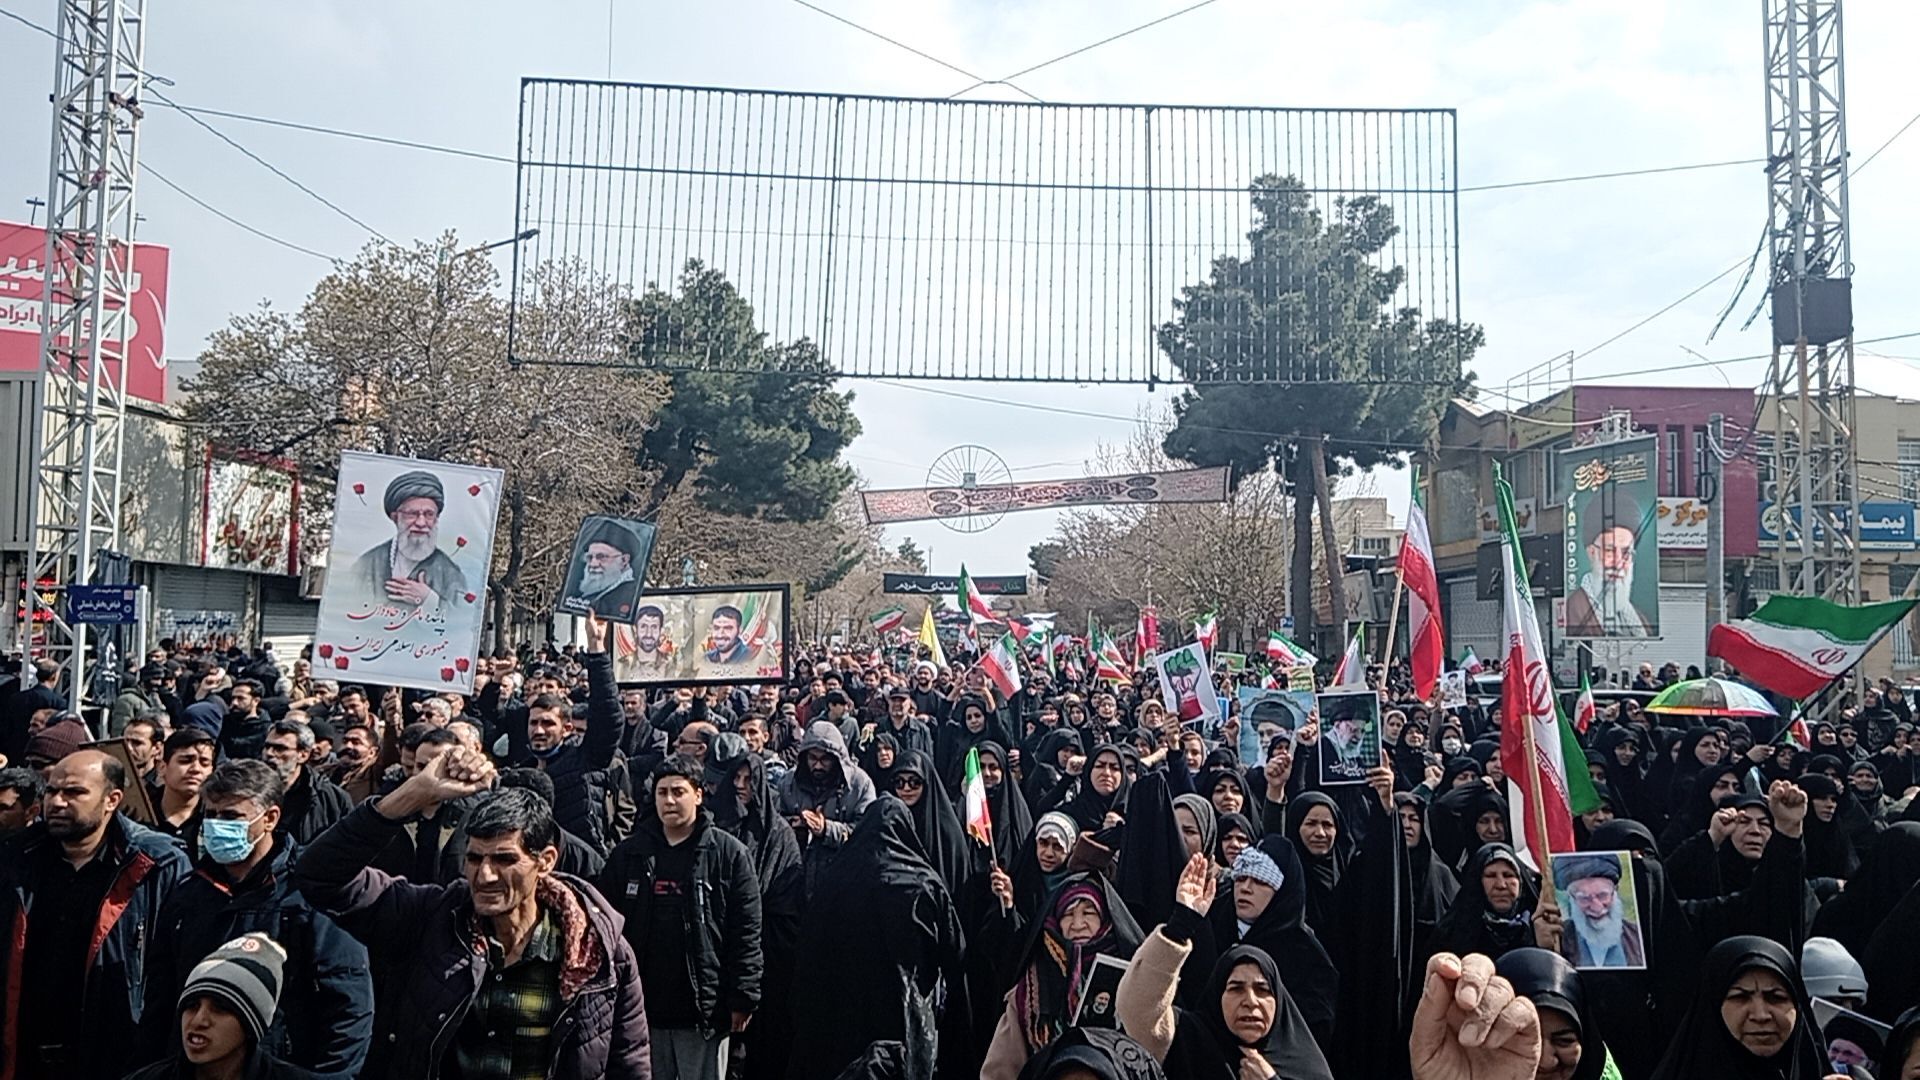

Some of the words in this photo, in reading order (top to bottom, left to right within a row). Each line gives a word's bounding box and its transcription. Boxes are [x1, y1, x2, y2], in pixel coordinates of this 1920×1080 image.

[337, 635, 385, 653] ایران
[359, 639, 415, 662] اسلامی
[413, 640, 449, 660] جمهوری
